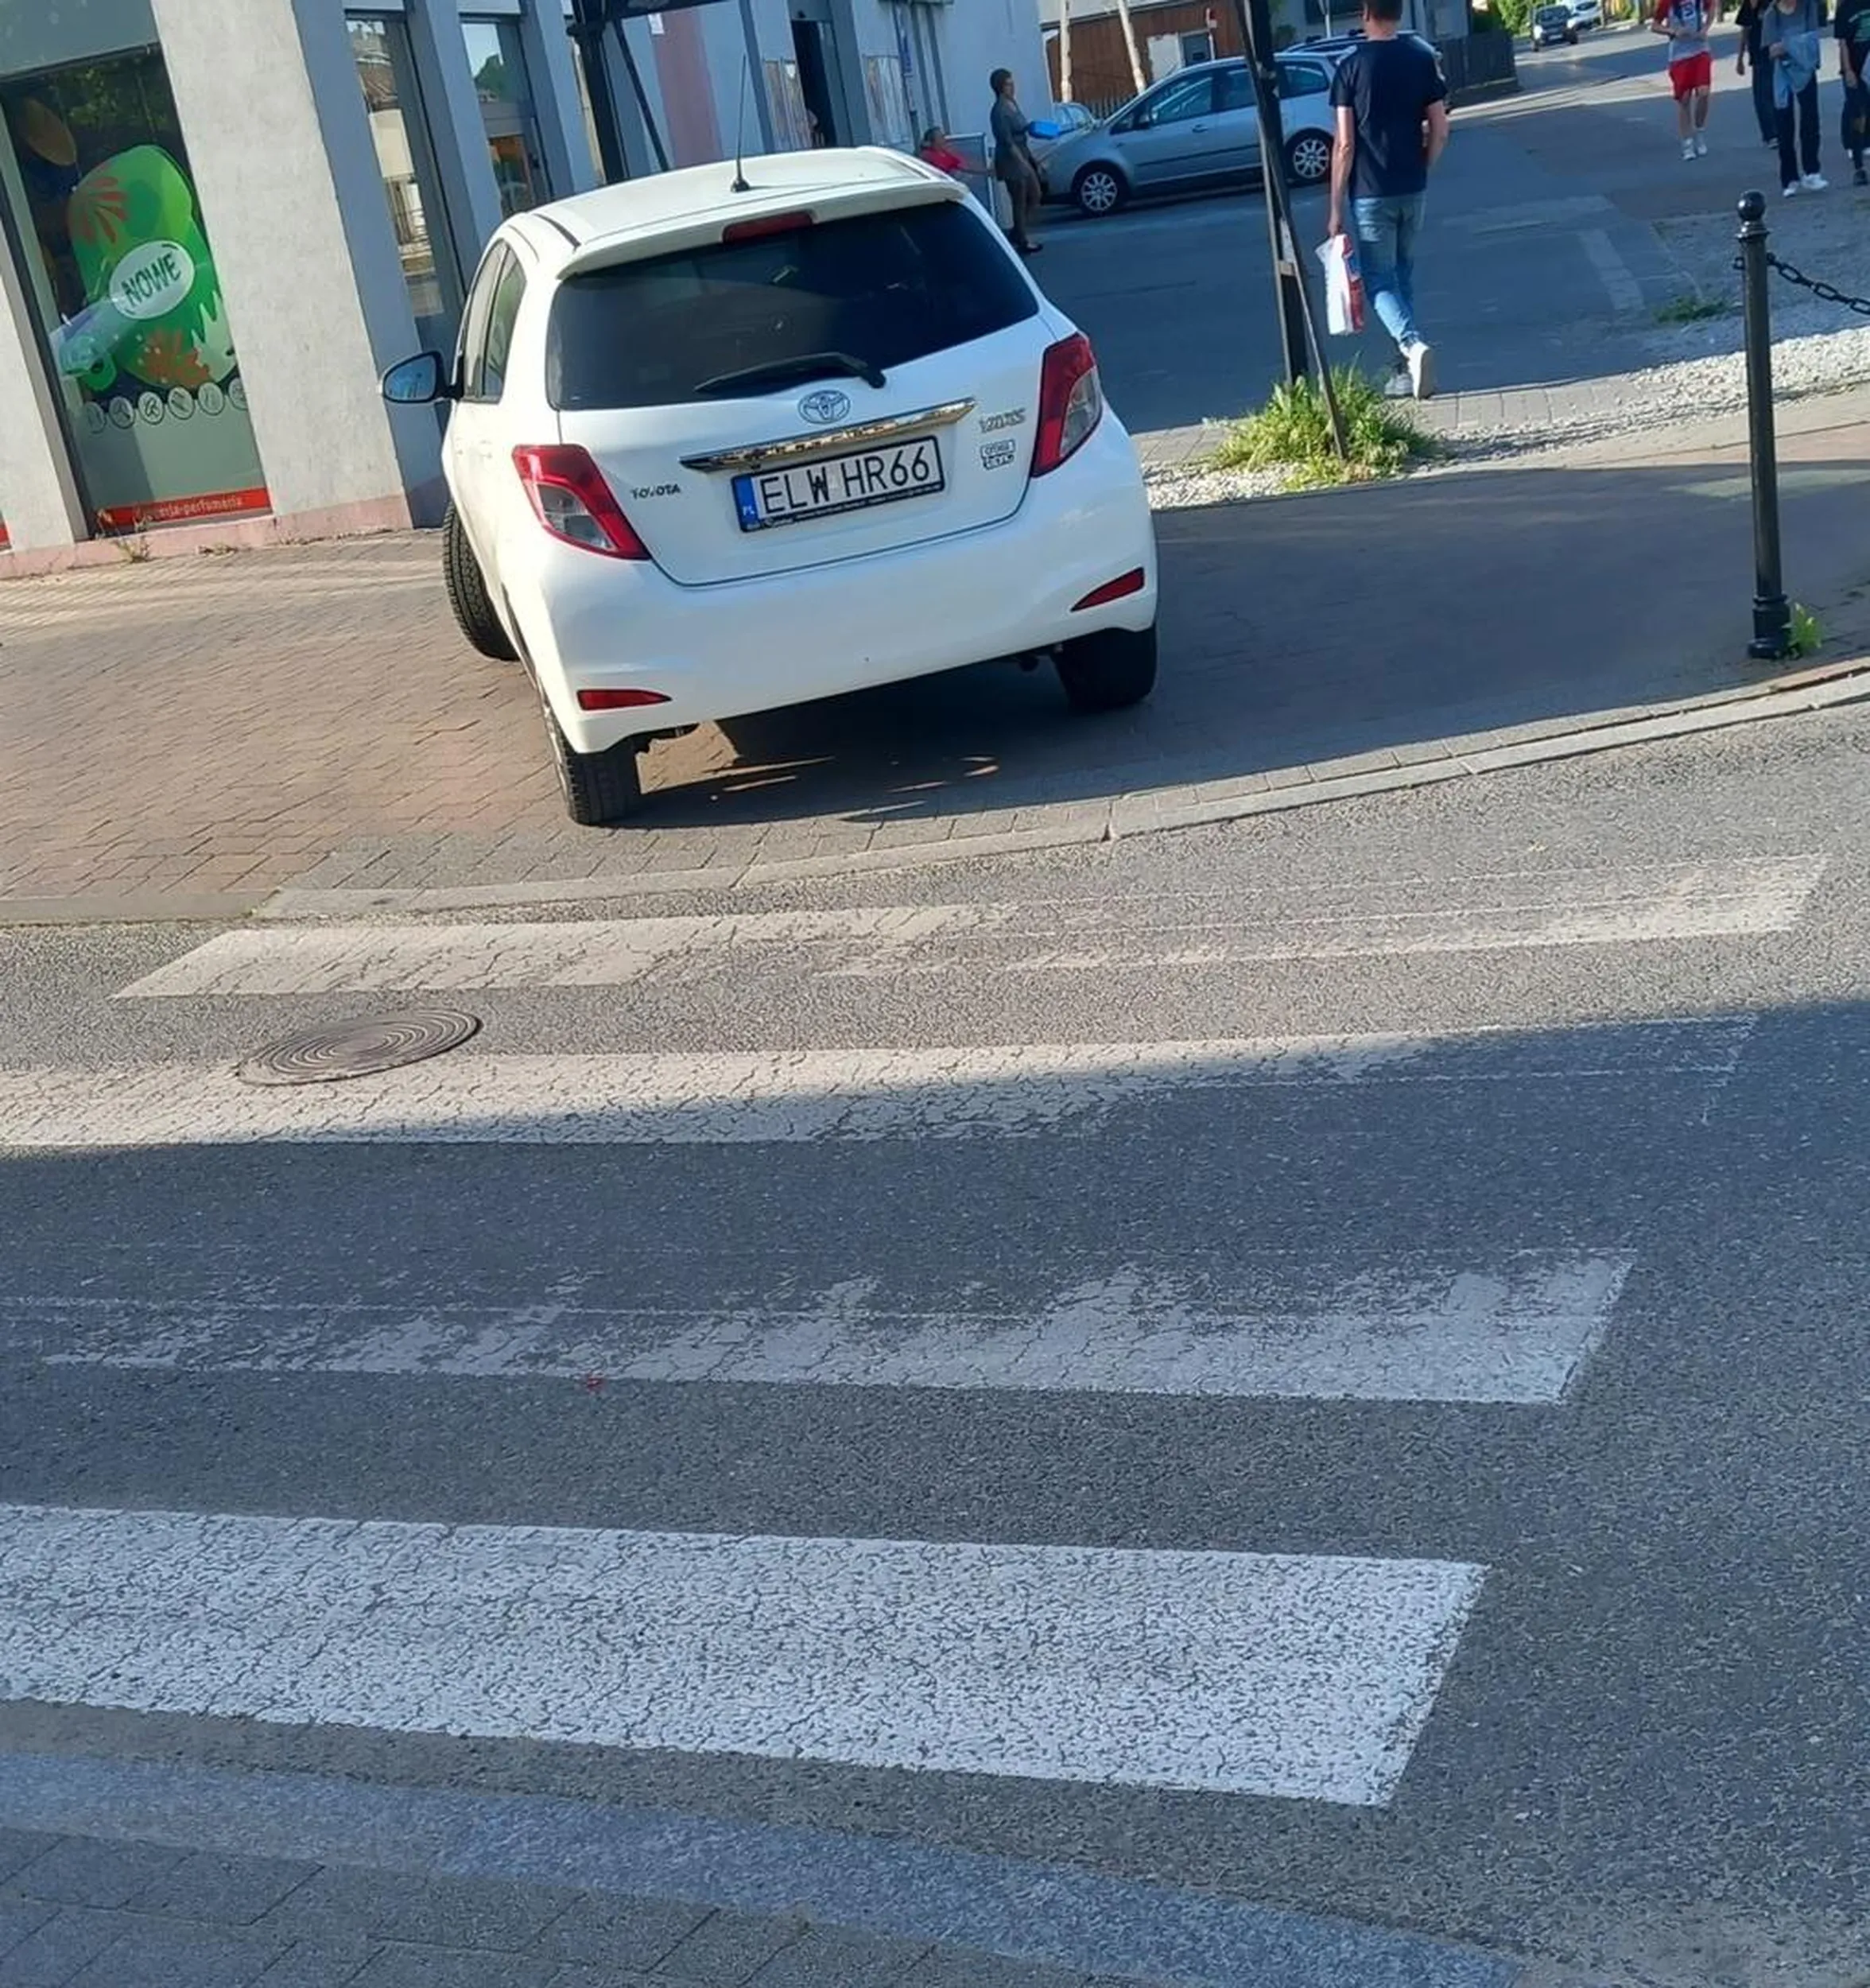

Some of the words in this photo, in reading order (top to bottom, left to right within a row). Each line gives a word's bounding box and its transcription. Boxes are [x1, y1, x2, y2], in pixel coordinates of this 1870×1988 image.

[121, 251, 180, 307] NOWE
[630, 483, 681, 499] TOYOTA
[759, 467, 830, 514] ELW
[840, 445, 930, 498] HR66
